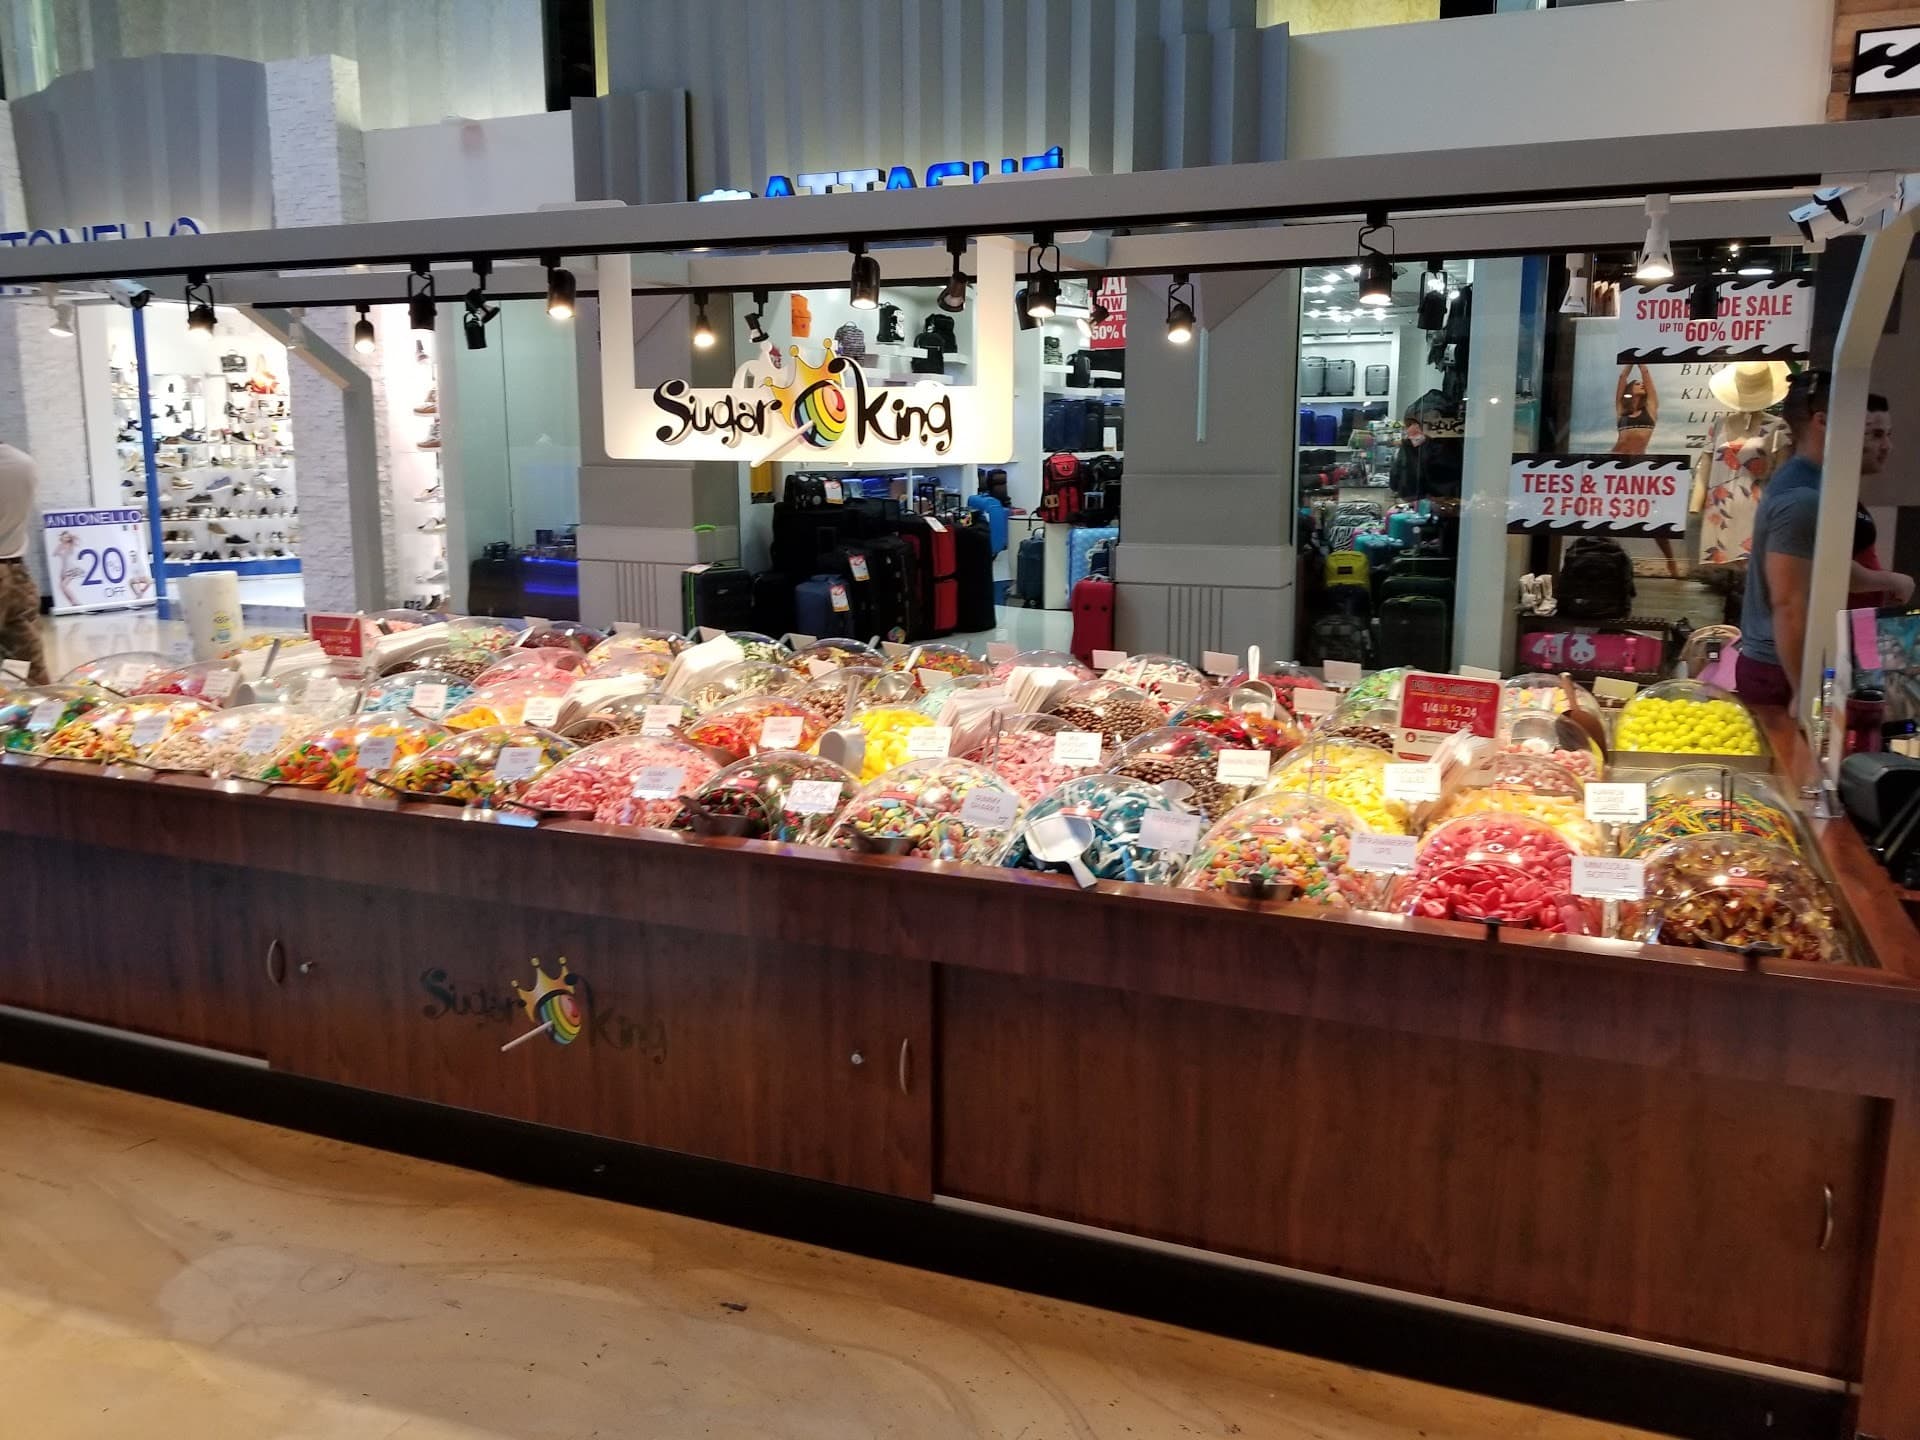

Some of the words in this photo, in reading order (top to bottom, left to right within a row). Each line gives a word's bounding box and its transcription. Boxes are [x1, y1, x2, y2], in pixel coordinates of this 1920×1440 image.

[1636, 296, 1742, 320] STOREDE
[1745, 294, 1793, 317] SALE
[1092, 325, 1120, 340] 50%
[1659, 322, 1671, 333] UP
[1672, 322, 1684, 333] TO
[1685, 319, 1726, 342] 60%
[653, 379, 782, 445] Sugar
[1522, 473, 1575, 494] TEES
[1580, 474, 1597, 495] &
[1604, 474, 1677, 496] TANKS
[1542, 496, 1555, 516] 2
[1560, 497, 1604, 517] FOR
[46, 510, 142, 528] ANTONELLO
